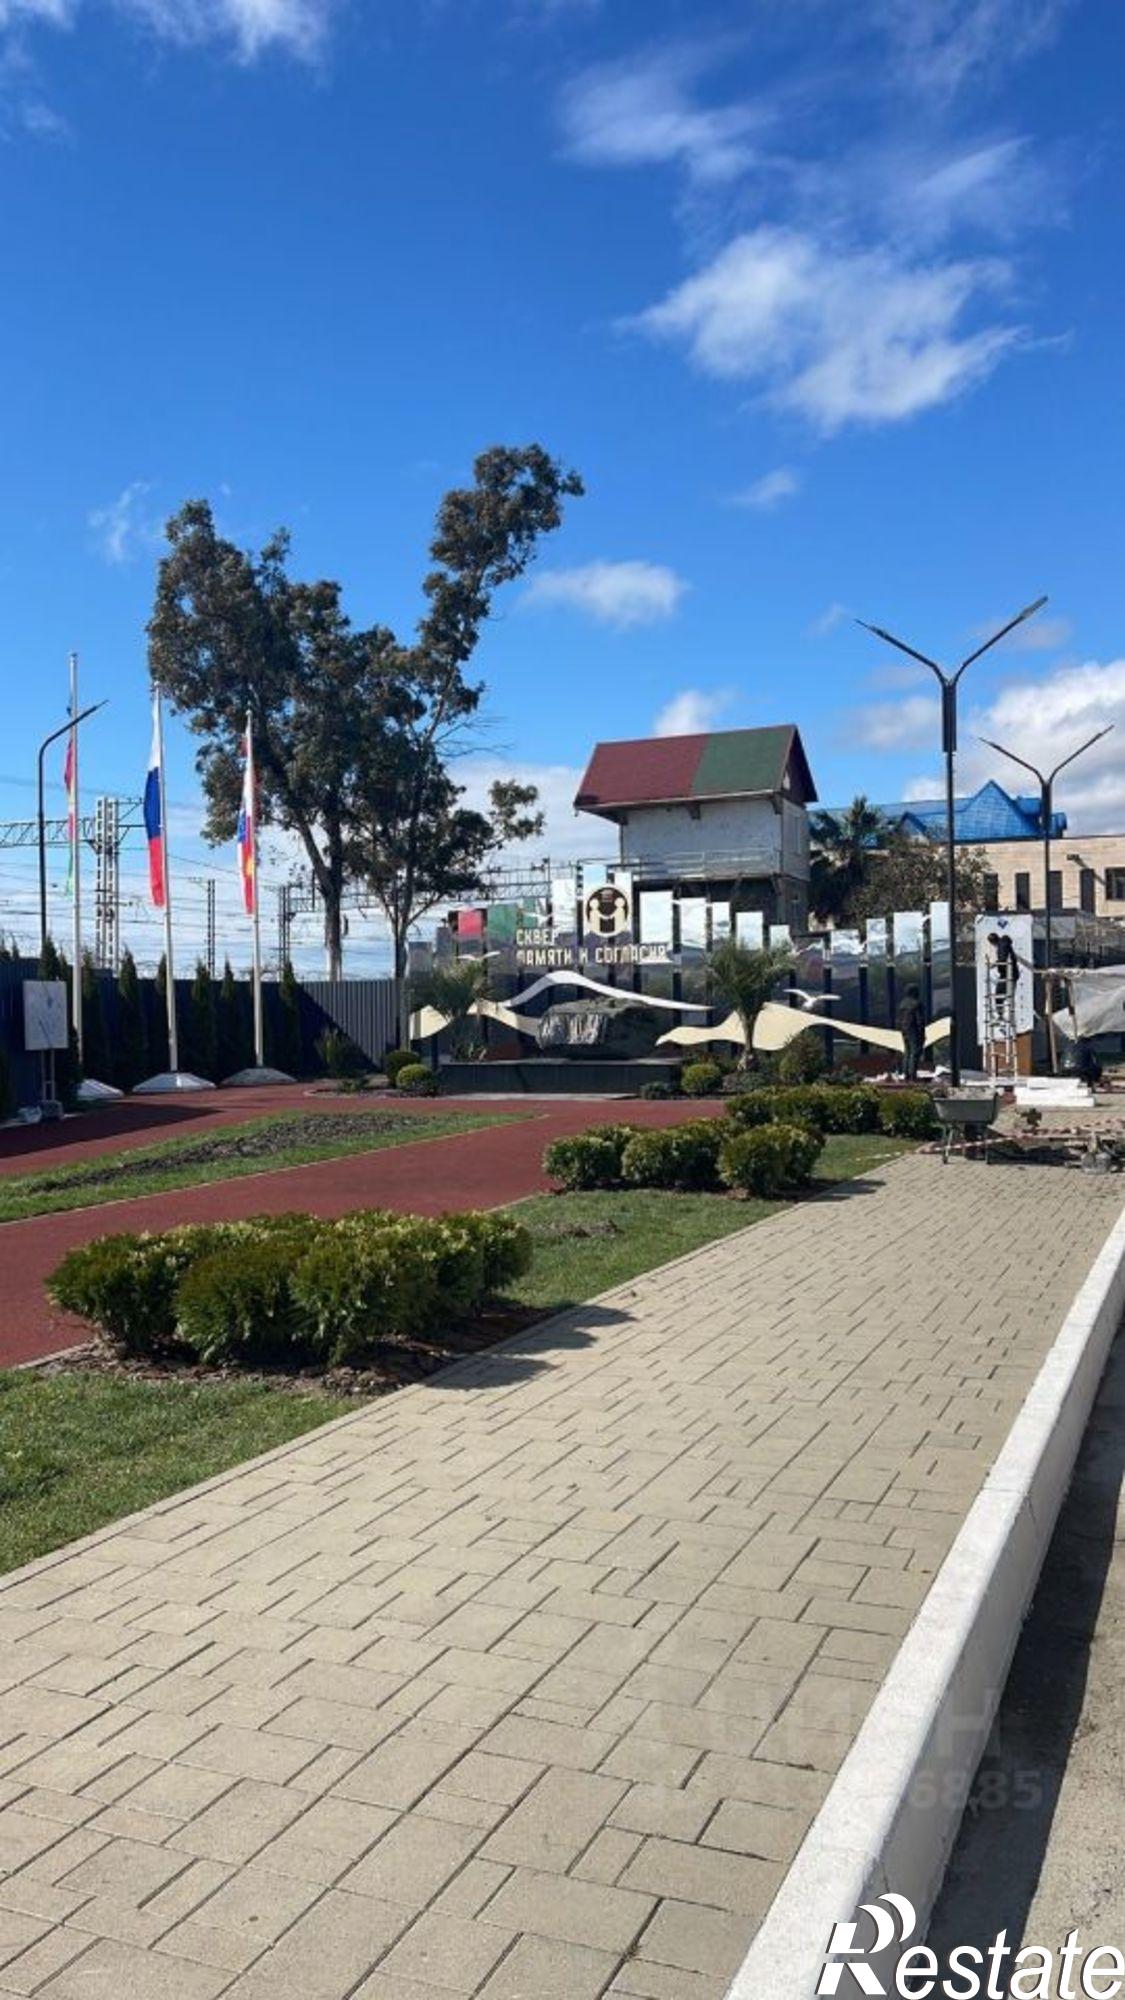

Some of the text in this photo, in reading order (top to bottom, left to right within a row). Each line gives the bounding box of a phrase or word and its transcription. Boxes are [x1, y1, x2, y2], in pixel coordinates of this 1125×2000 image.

[516, 928, 559, 946] СКВЕР
[516, 947, 572, 966] ПАМЯТИ
[578, 947, 588, 965] И
